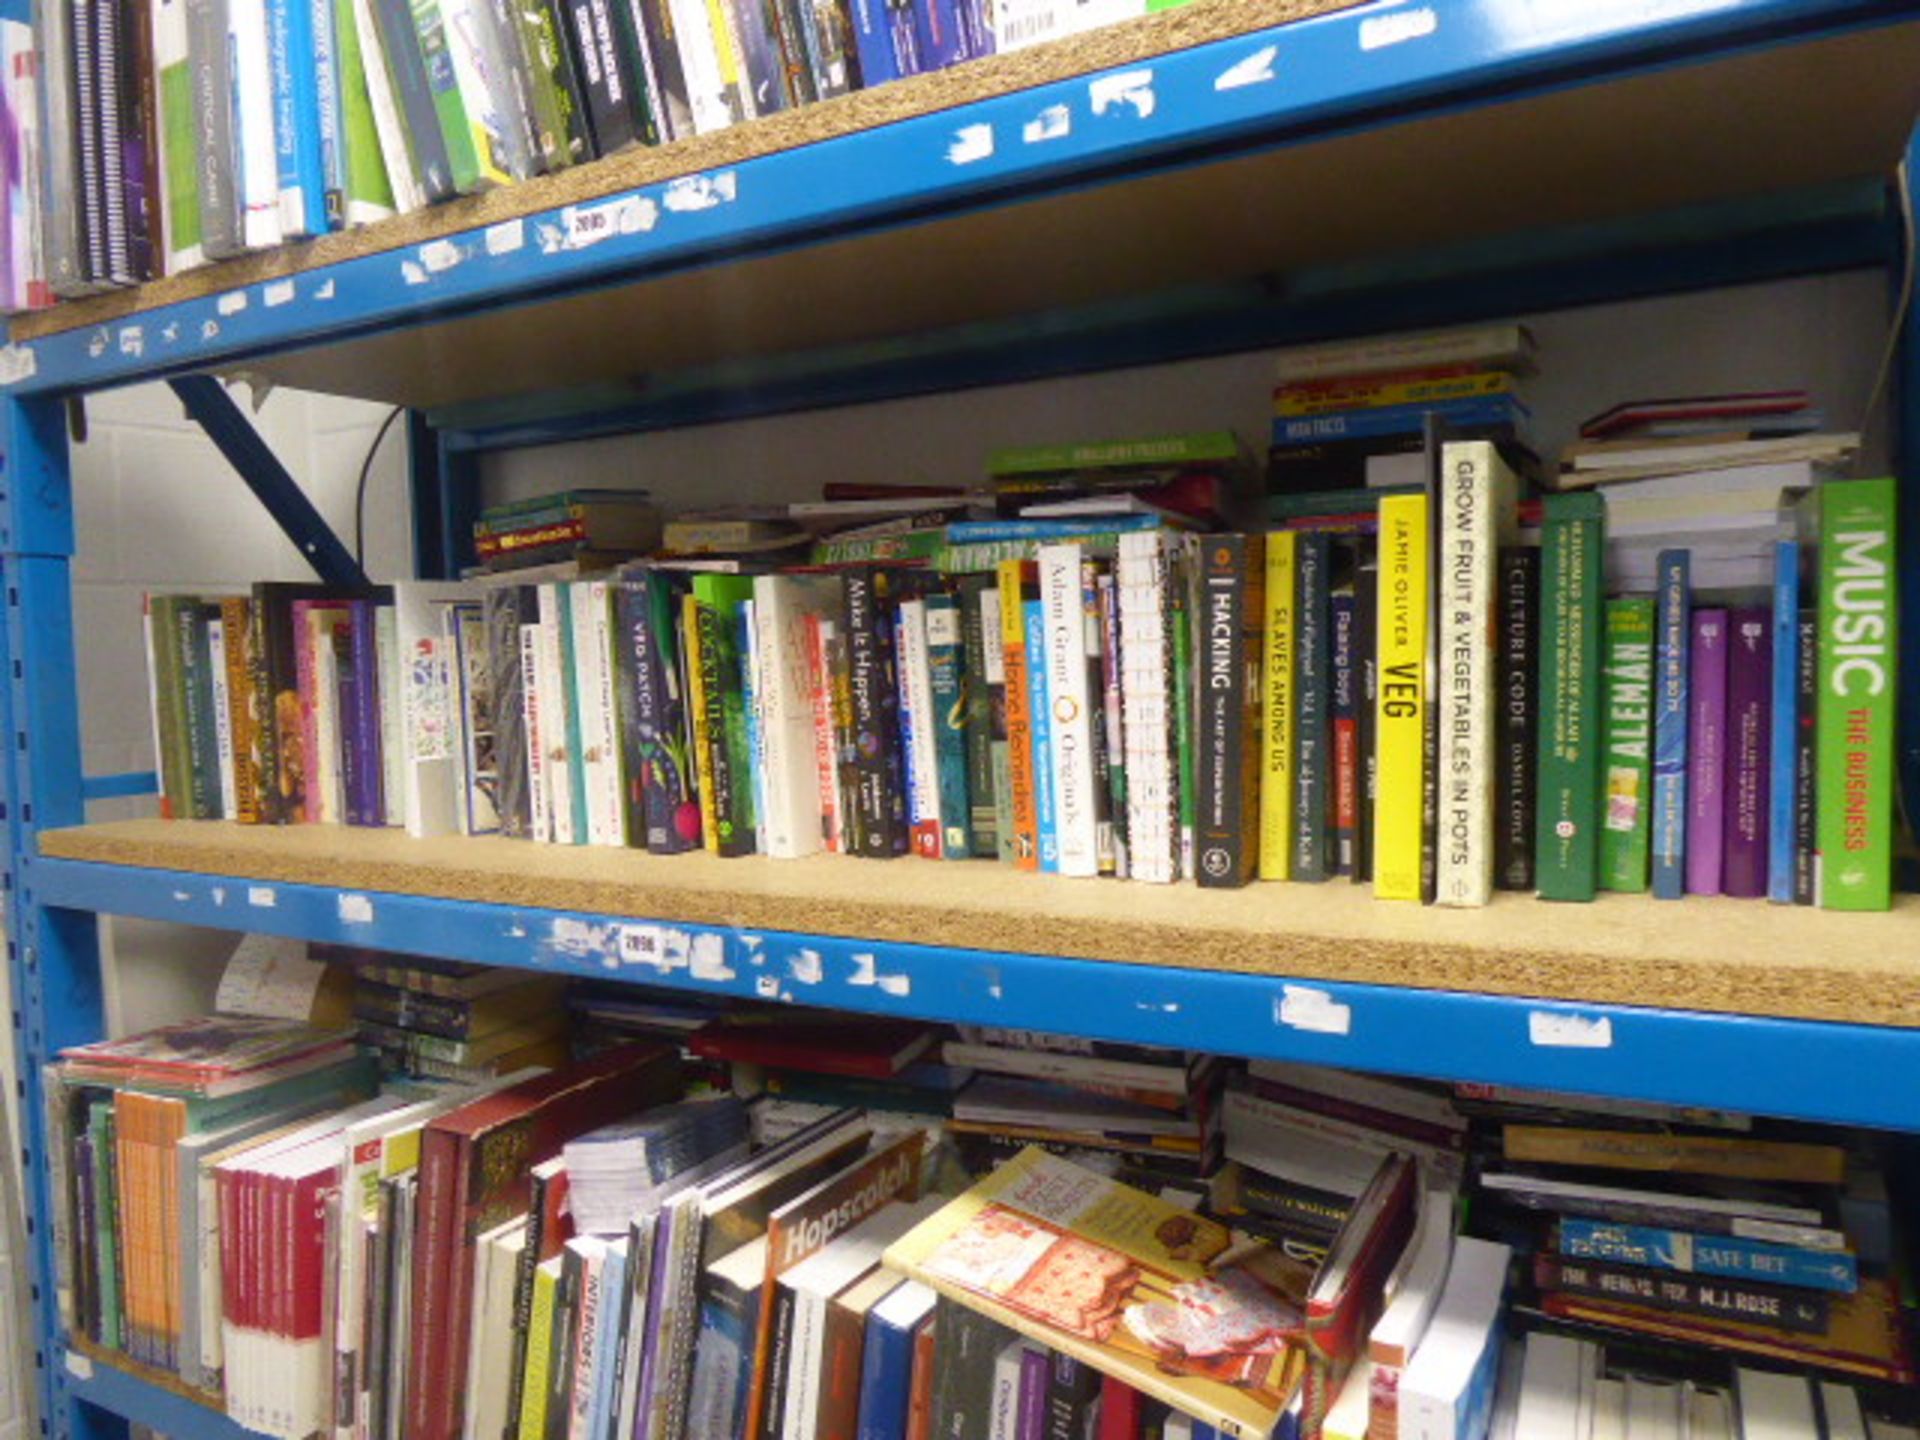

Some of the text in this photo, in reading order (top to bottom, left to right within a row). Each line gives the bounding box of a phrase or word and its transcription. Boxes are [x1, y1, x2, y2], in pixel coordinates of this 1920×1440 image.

[278, 97, 294, 154] Imaging
[847, 578, 867, 628] Make
[1051, 564, 1072, 686] Adam Grant
[1394, 518, 1411, 648] JAMIE OLIVER
[1510, 568, 1525, 661] CULTURE
[699, 611, 723, 740] COCKTAILS
[851, 651, 873, 722] Happen
[1004, 651, 1025, 714] Home
[1211, 592, 1232, 689] HACKING
[1334, 610, 1352, 707] Raising boys
[1452, 460, 1475, 866] GROW FRUIT & VEGETABLES IN POTS
[637, 662, 652, 718] PATCH
[1215, 717, 1225, 738] ART
[1216, 695, 1226, 715] THE
[1270, 607, 1288, 773] SLAVES AMONG US
[1383, 663, 1418, 719] VEG
[1510, 671, 1525, 727] CODE
[1604, 643, 1651, 759] ALEMÁN
[1832, 530, 1887, 852] MUSIC THE BUSINESS
[1010, 720, 1030, 822] Remedies
[1060, 733, 1080, 825] Originals
[1215, 739, 1225, 754] OF
[785, 1153, 910, 1263] Hopscotch
[1696, 1246, 1788, 1274] SAFE BET
[1735, 1292, 1781, 1317] ROSE
[581, 1274, 600, 1370] INTERIORS
